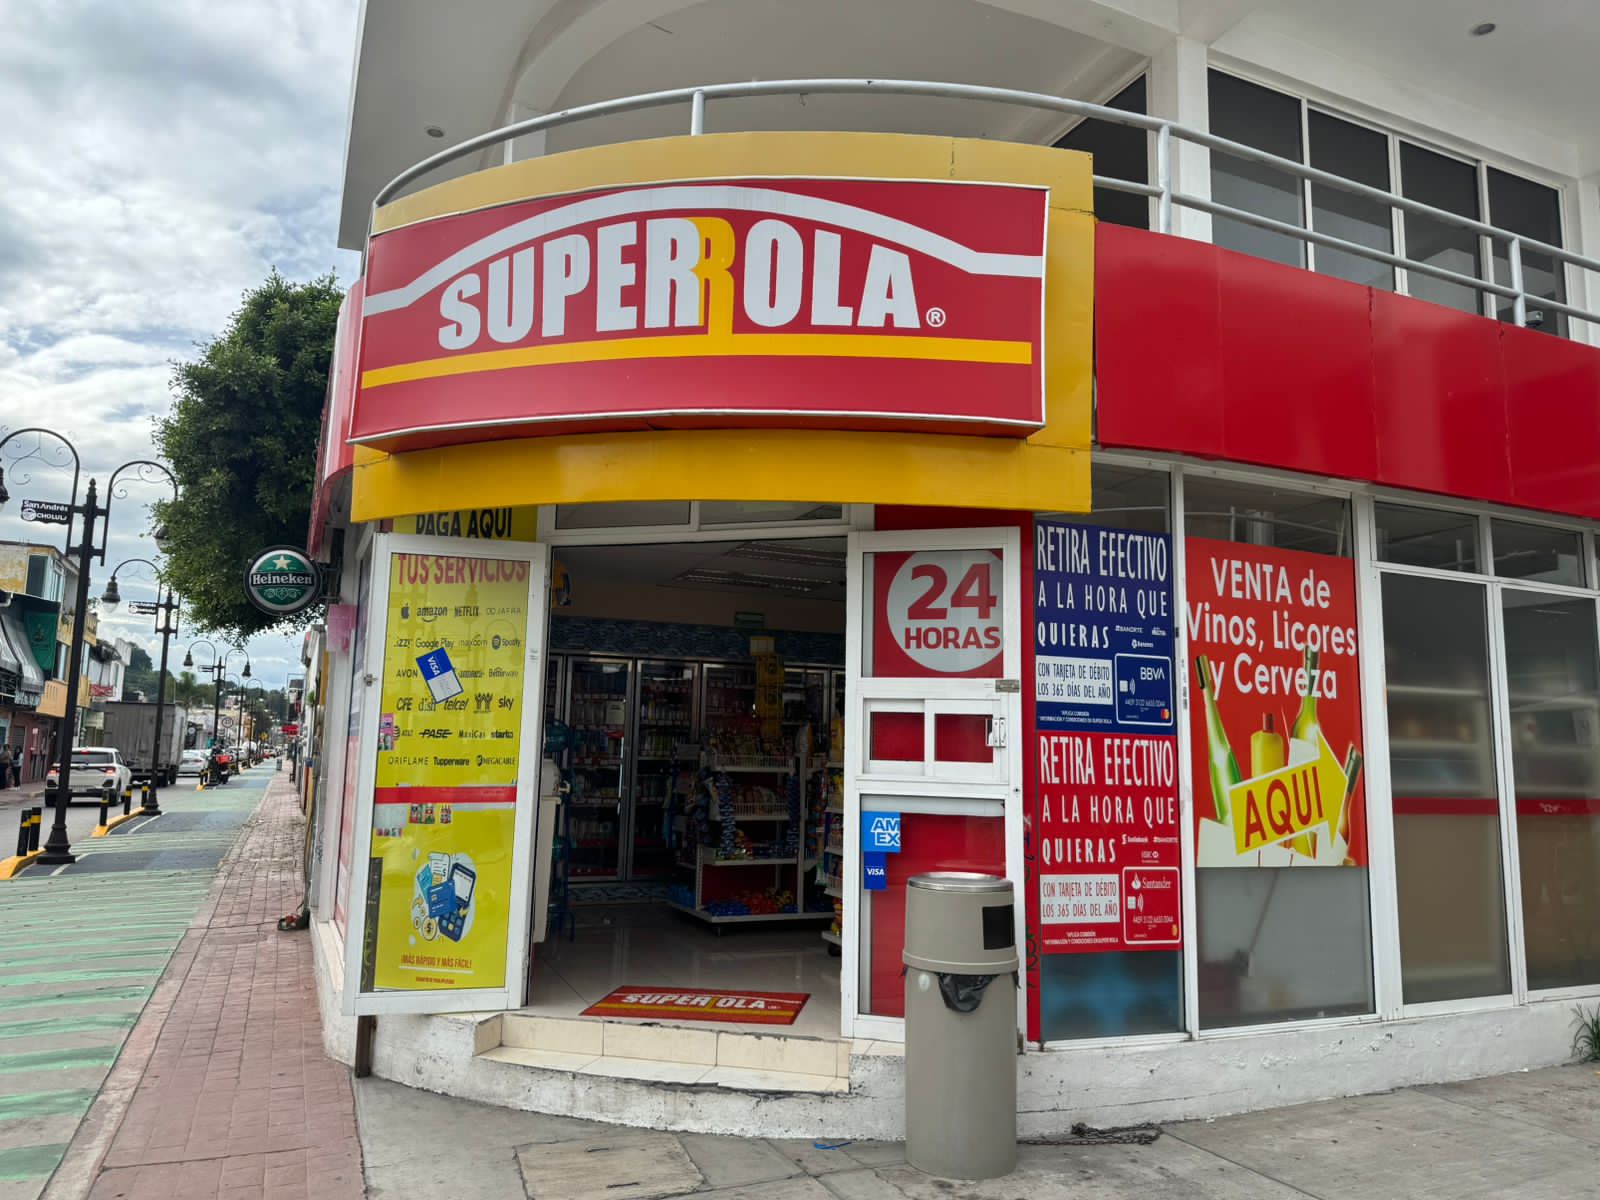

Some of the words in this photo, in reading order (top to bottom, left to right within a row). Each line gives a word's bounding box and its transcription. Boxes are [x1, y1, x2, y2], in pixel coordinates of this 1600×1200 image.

[23, 500, 40, 508] San
[1036, 525, 1090, 574] RETIRA
[1099, 530, 1167, 582] EFECTIVO
[252, 573, 312, 585] Heineken
[398, 554, 429, 584] TUS
[434, 556, 526, 584] SERVICIOS
[907, 563, 997, 620] 24
[1210, 557, 1293, 605] VENTA
[1300, 569, 1331, 608] de
[1038, 580, 1046, 608] A
[1057, 582, 1074, 609] LA
[1084, 584, 1128, 614] HORA
[1137, 589, 1168, 620] QUE
[416, 606, 448, 617] amazon
[454, 606, 479, 617] NETFLIX
[904, 626, 1001, 650] HORAS
[1037, 622, 1110, 649] QUIERAS
[1186, 601, 1264, 653] Vinos,
[1272, 610, 1356, 656] Licores
[416, 638, 438, 649] Google
[440, 638, 454, 648] Play
[502, 638, 521, 648] Spotify
[396, 669, 418, 678] AVON
[427, 655, 440, 676] VISA
[1038, 662, 1050, 676] CON
[1053, 664, 1076, 682] TARJETA
[1078, 665, 1086, 679] DE
[1090, 662, 1110, 680] DÉBITO
[1140, 666, 1166, 680] BBVA
[1210, 660, 1225, 701] y
[1233, 652, 1337, 699] Cerveza
[1038, 682, 1048, 696] LOS
[1052, 683, 1064, 696] 365
[1067, 682, 1081, 697] DÍAS
[1084, 685, 1096, 698] DEL
[1098, 684, 1111, 699] AÑO
[396, 696, 414, 710] CFE
[444, 698, 469, 711] telcel
[498, 696, 514, 710] sky
[421, 729, 451, 738] PASE
[388, 756, 428, 766] ORIFLAME
[434, 756, 470, 766] Tupperware
[1040, 736, 1096, 785] RETIRA
[1104, 738, 1174, 787] EFECTIVO
[1042, 794, 1051, 823] A
[1061, 795, 1080, 824] LA
[1090, 795, 1134, 824] HORA
[1144, 796, 1175, 829] QUE
[1244, 766, 1324, 848] AQUI
[1042, 838, 1116, 865] QUIERAS
[866, 868, 884, 876] VISA
[1142, 876, 1171, 888] Santander
[1042, 882, 1056, 897] CON
[1058, 882, 1082, 900] TARJETA
[1084, 882, 1092, 896] DE
[1096, 878, 1116, 896] DÉBITO
[1042, 904, 1054, 918] LOS
[1058, 904, 1069, 917] 365
[1072, 900, 1086, 917] DÍAS
[1090, 904, 1102, 916] DEL
[1104, 900, 1118, 916] AÑO
[437, 958, 440, 967] Y
[442, 956, 454, 968] MÁS
[454, 957, 472, 968] FÁCIL!
